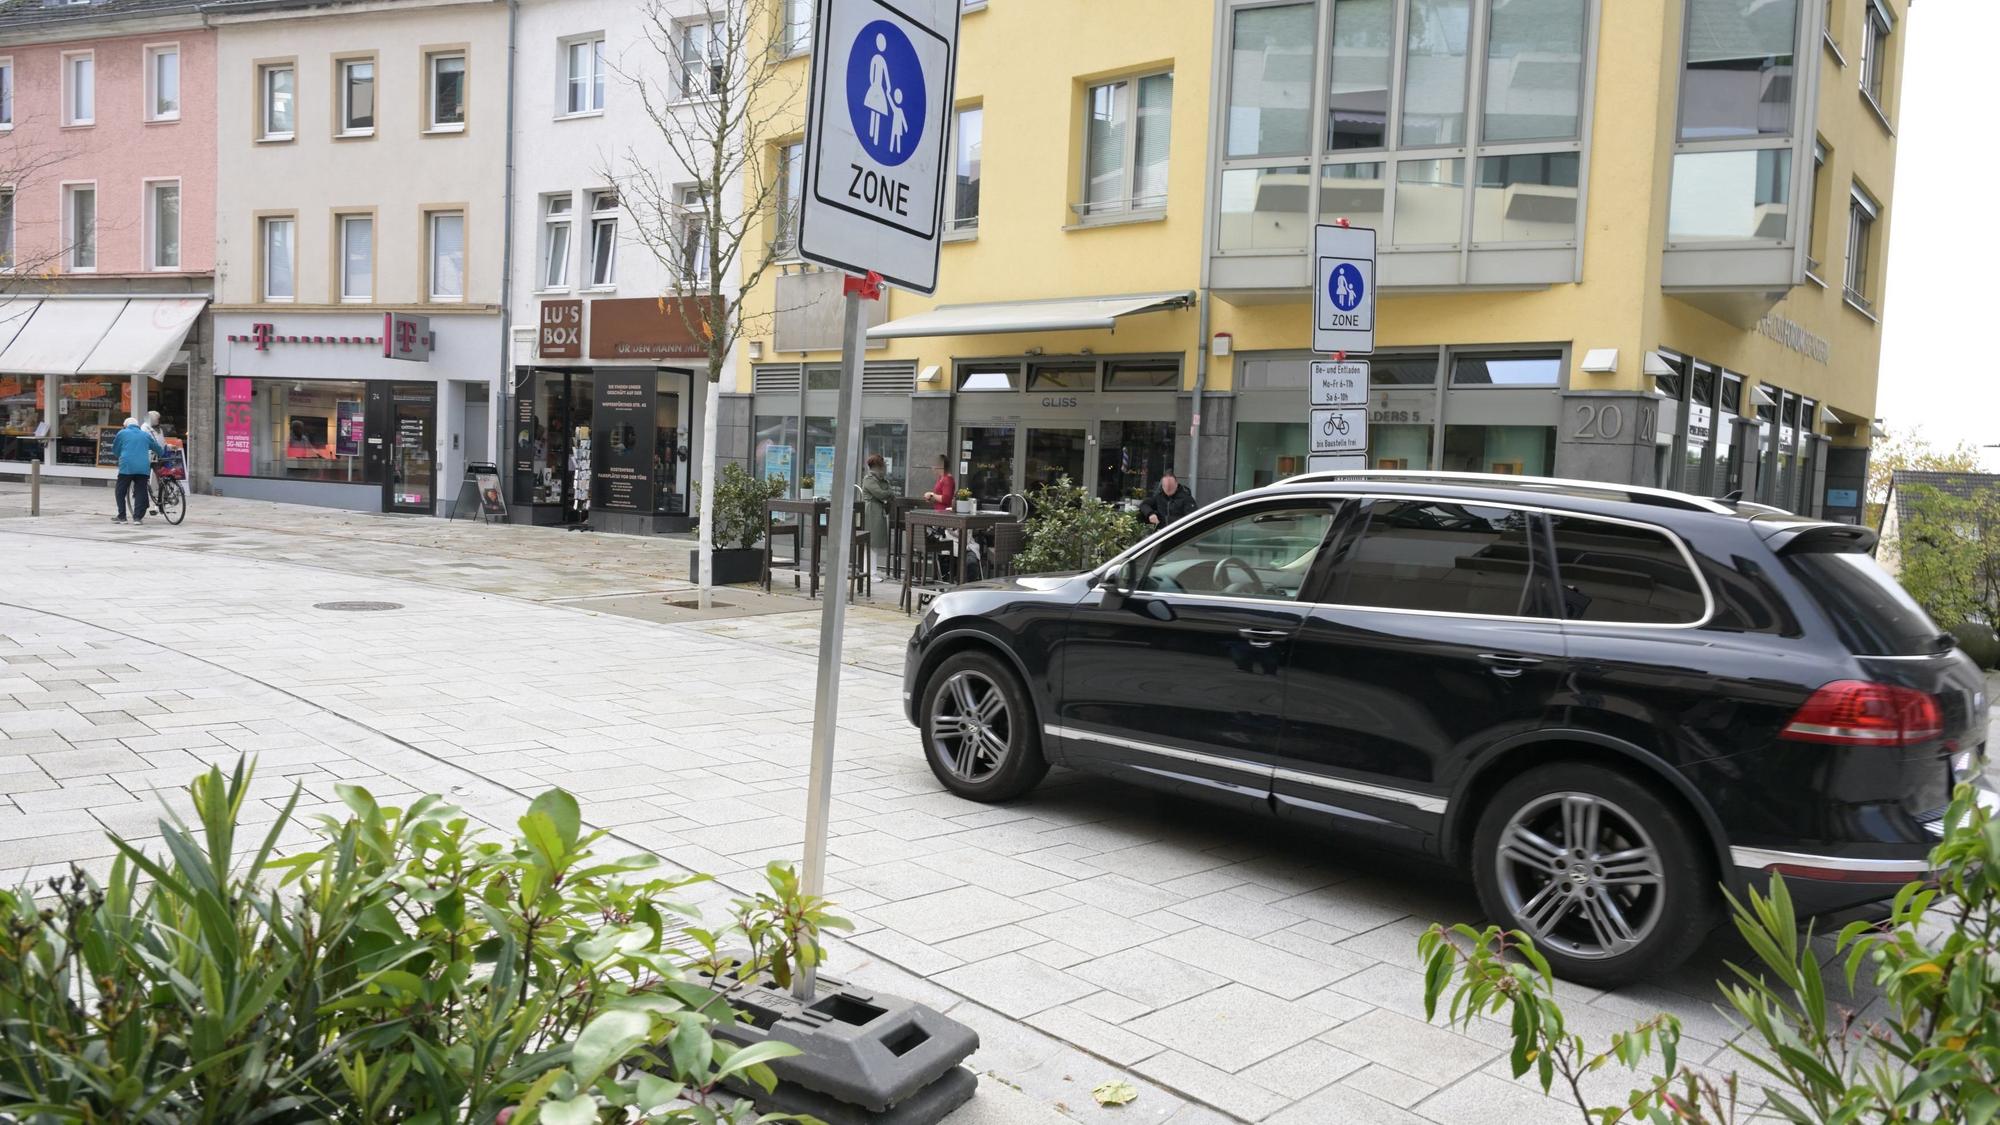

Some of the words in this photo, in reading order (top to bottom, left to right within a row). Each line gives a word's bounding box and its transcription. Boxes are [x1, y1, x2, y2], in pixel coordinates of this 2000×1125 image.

[848, 163, 910, 217] ZONE
[543, 306, 579, 324] LU'S
[1332, 314, 1359, 327] ZONE
[543, 327, 578, 345] BOX
[1327, 365, 1336, 374] und
[1041, 397, 1077, 408] GLISS
[1326, 392, 1333, 402] Sa
[225, 404, 252, 431] 5G
[1412, 411, 1420, 422] 5
[1573, 404, 1625, 440] 20
[1640, 406, 1657, 442] 20
